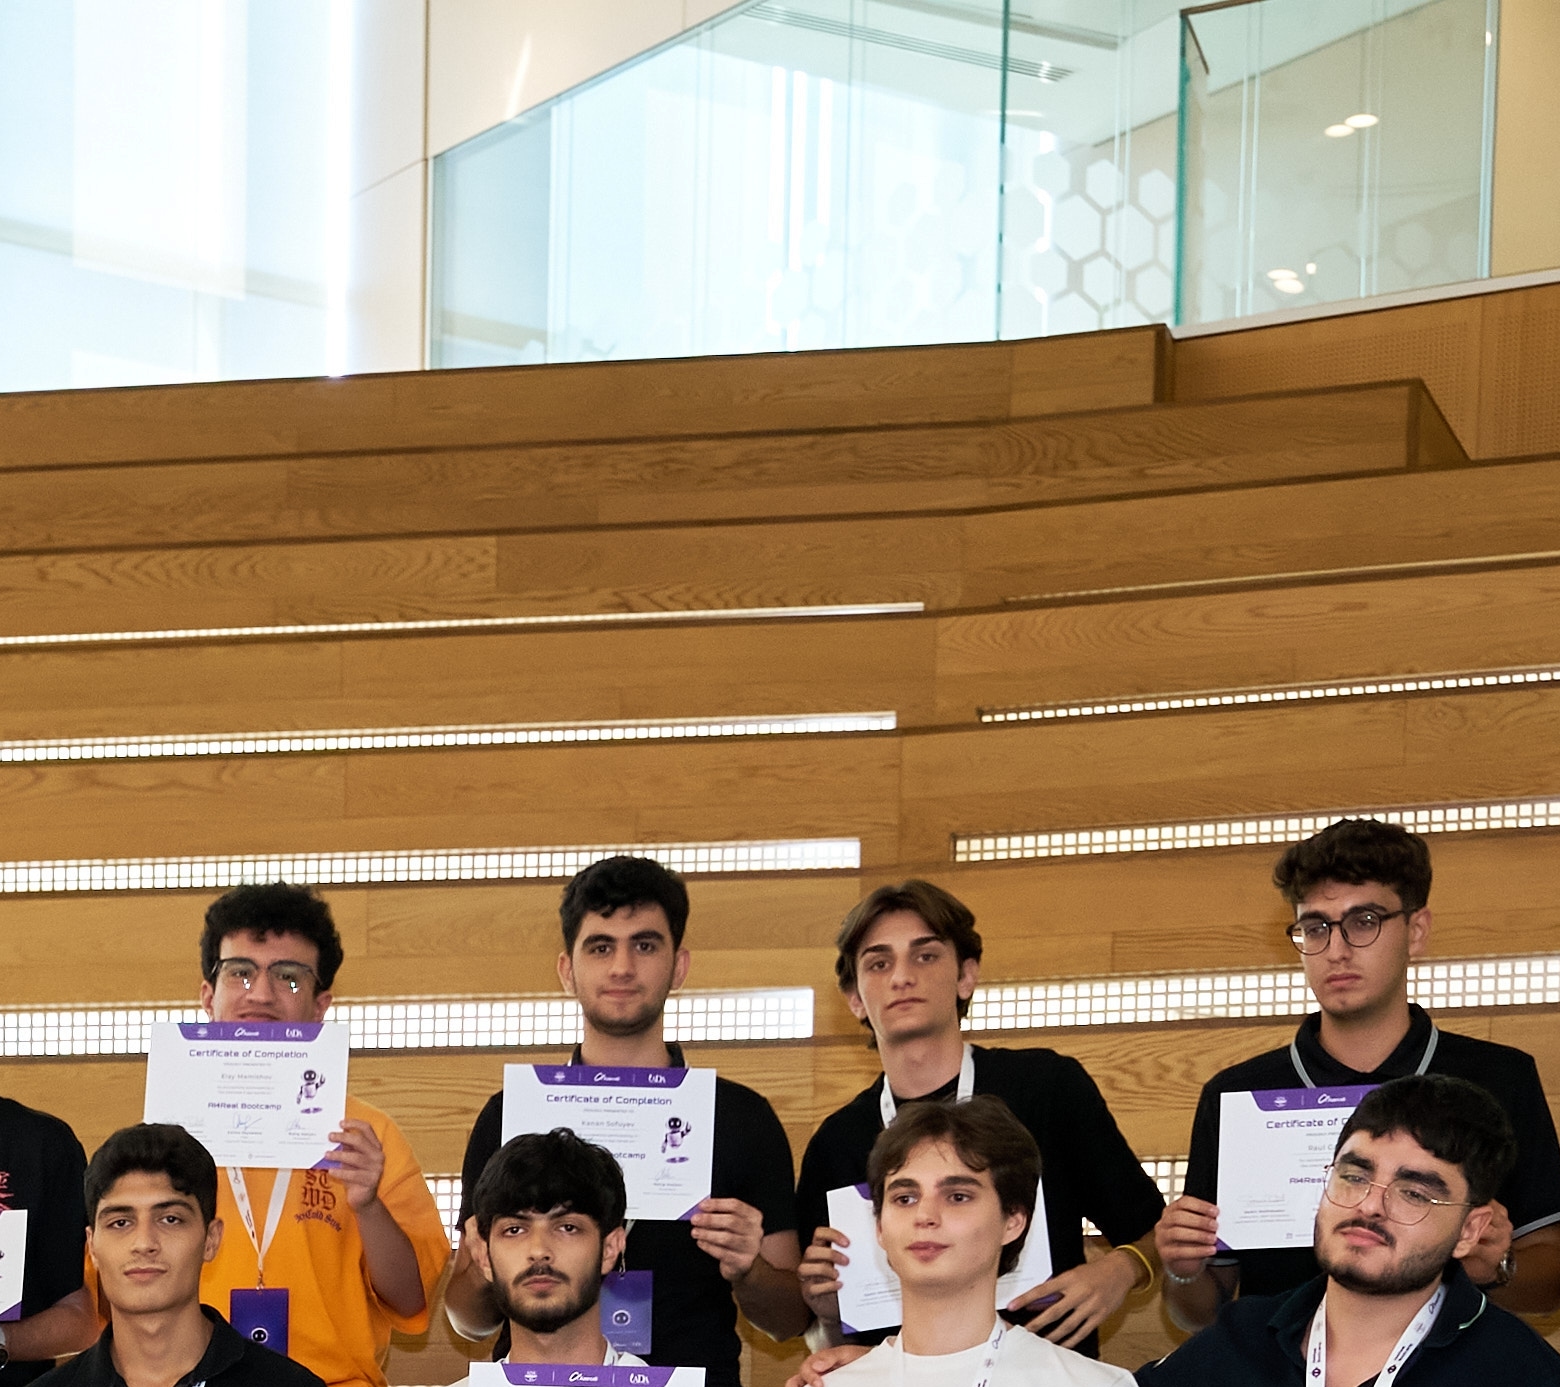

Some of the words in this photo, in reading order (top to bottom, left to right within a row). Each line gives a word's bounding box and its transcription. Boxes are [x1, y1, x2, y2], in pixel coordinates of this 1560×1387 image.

[189, 1050, 239, 1058] Certificate
[255, 1051, 307, 1059] Completion
[547, 1094, 599, 1103] Certificate
[616, 1096, 672, 1106] Completion
[1267, 1119, 1323, 1129] Certificate
